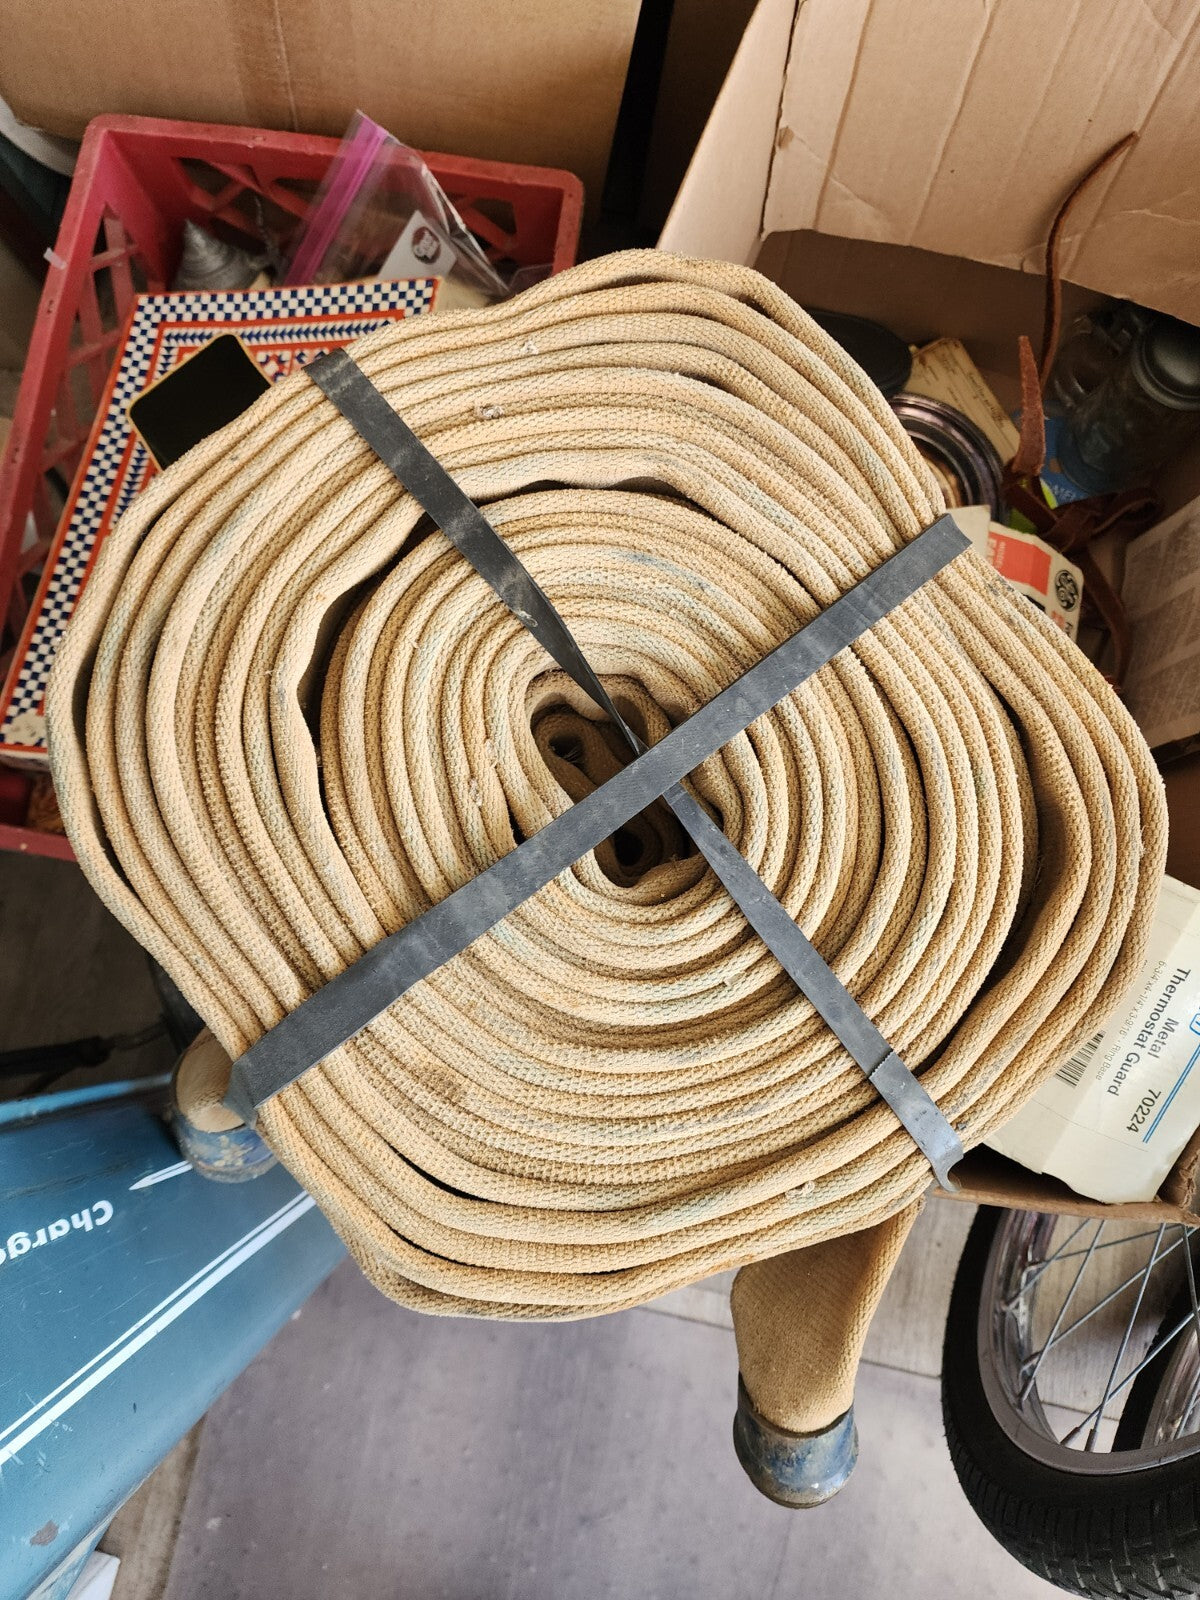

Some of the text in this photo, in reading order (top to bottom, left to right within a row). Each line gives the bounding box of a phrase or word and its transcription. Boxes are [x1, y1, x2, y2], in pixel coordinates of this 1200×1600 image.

[1106, 968, 1192, 1096] Thermostat Guard
[1147, 1017, 1180, 1058] Metal
[1095, 1061, 1111, 1081] Base
[1103, 1044, 1122, 1063] Ring
[1126, 1089, 1162, 1133] 70224
